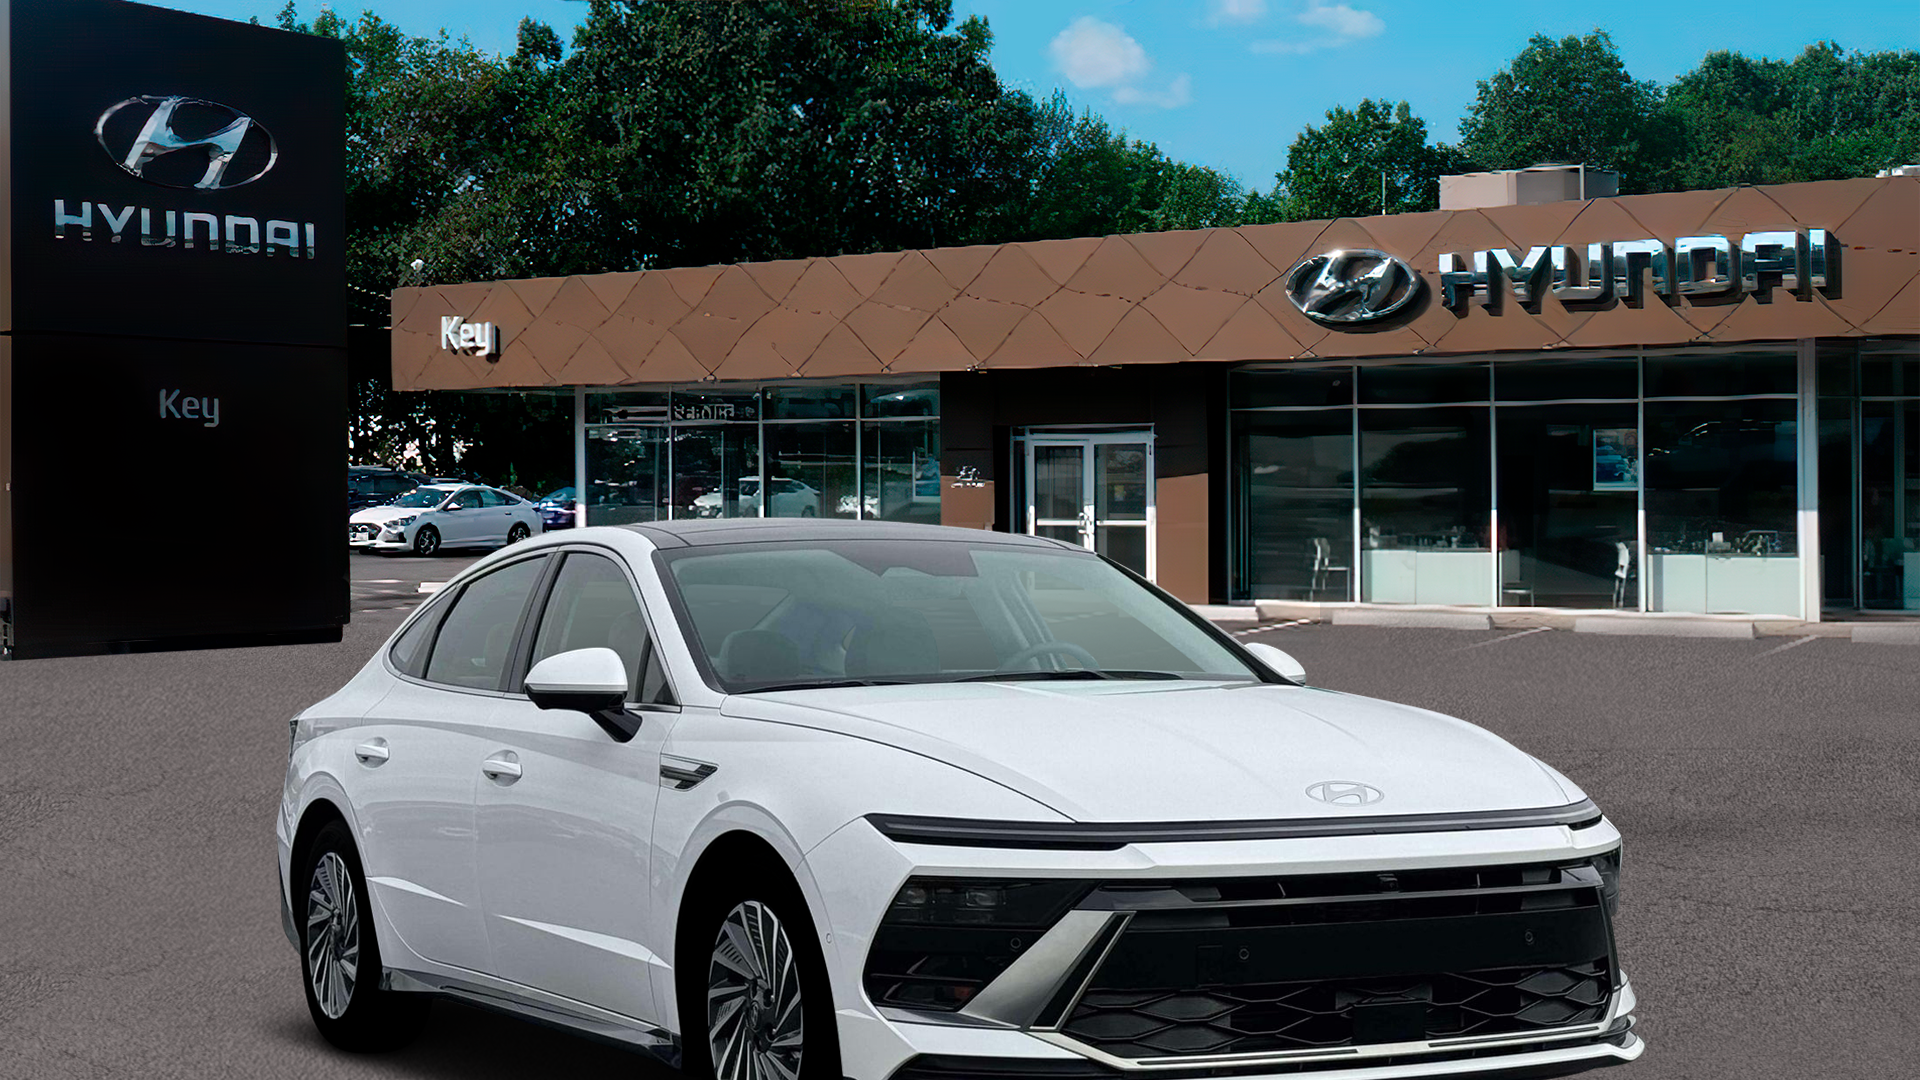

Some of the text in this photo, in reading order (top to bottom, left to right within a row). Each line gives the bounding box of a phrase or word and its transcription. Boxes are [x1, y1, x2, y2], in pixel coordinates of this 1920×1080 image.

[54, 198, 315, 260] HYUNDAI
[1438, 228, 1836, 312] HYUNDAI
[440, 315, 494, 357] Key
[159, 388, 220, 428] Key
